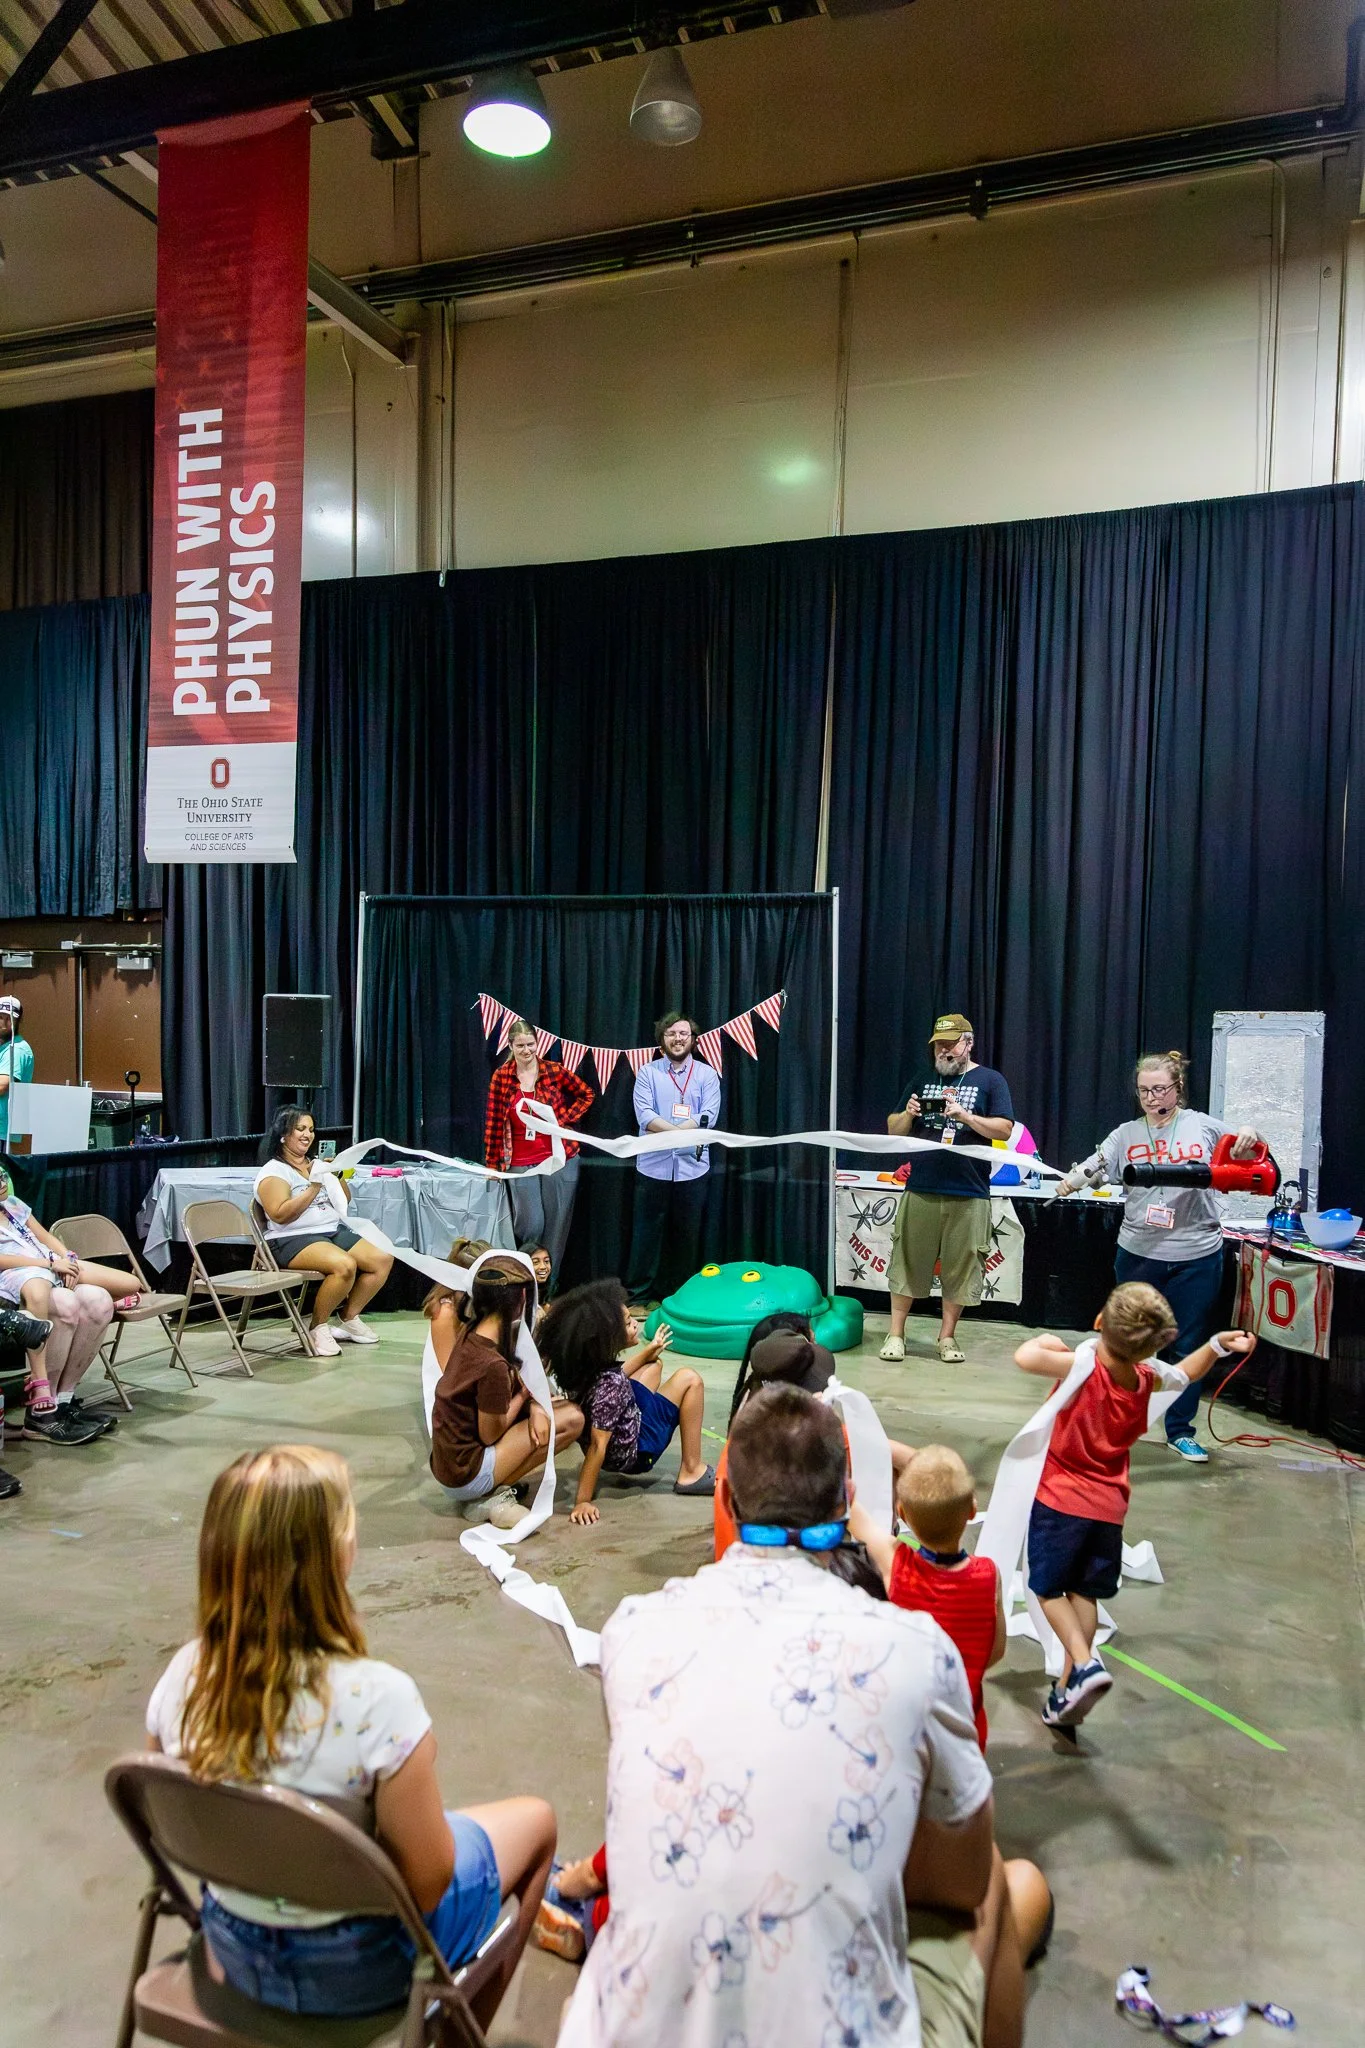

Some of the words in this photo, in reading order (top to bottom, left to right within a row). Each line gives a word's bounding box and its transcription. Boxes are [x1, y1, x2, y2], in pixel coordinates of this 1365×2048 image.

[177, 408, 223, 553] WITH
[226, 481, 276, 714] PHYSICS
[173, 567, 220, 715] PHUN
[211, 758, 230, 788] O
[184, 833, 220, 841] COLLEGE
[221, 832, 232, 841] OF
[233, 832, 254, 841] ARTS
[190, 843, 208, 851] AND
[208, 842, 247, 851] SCIENCES
[848, 1232, 872, 1261] THIS
[870, 1255, 887, 1273] IS
[1265, 1277, 1298, 1329] O
